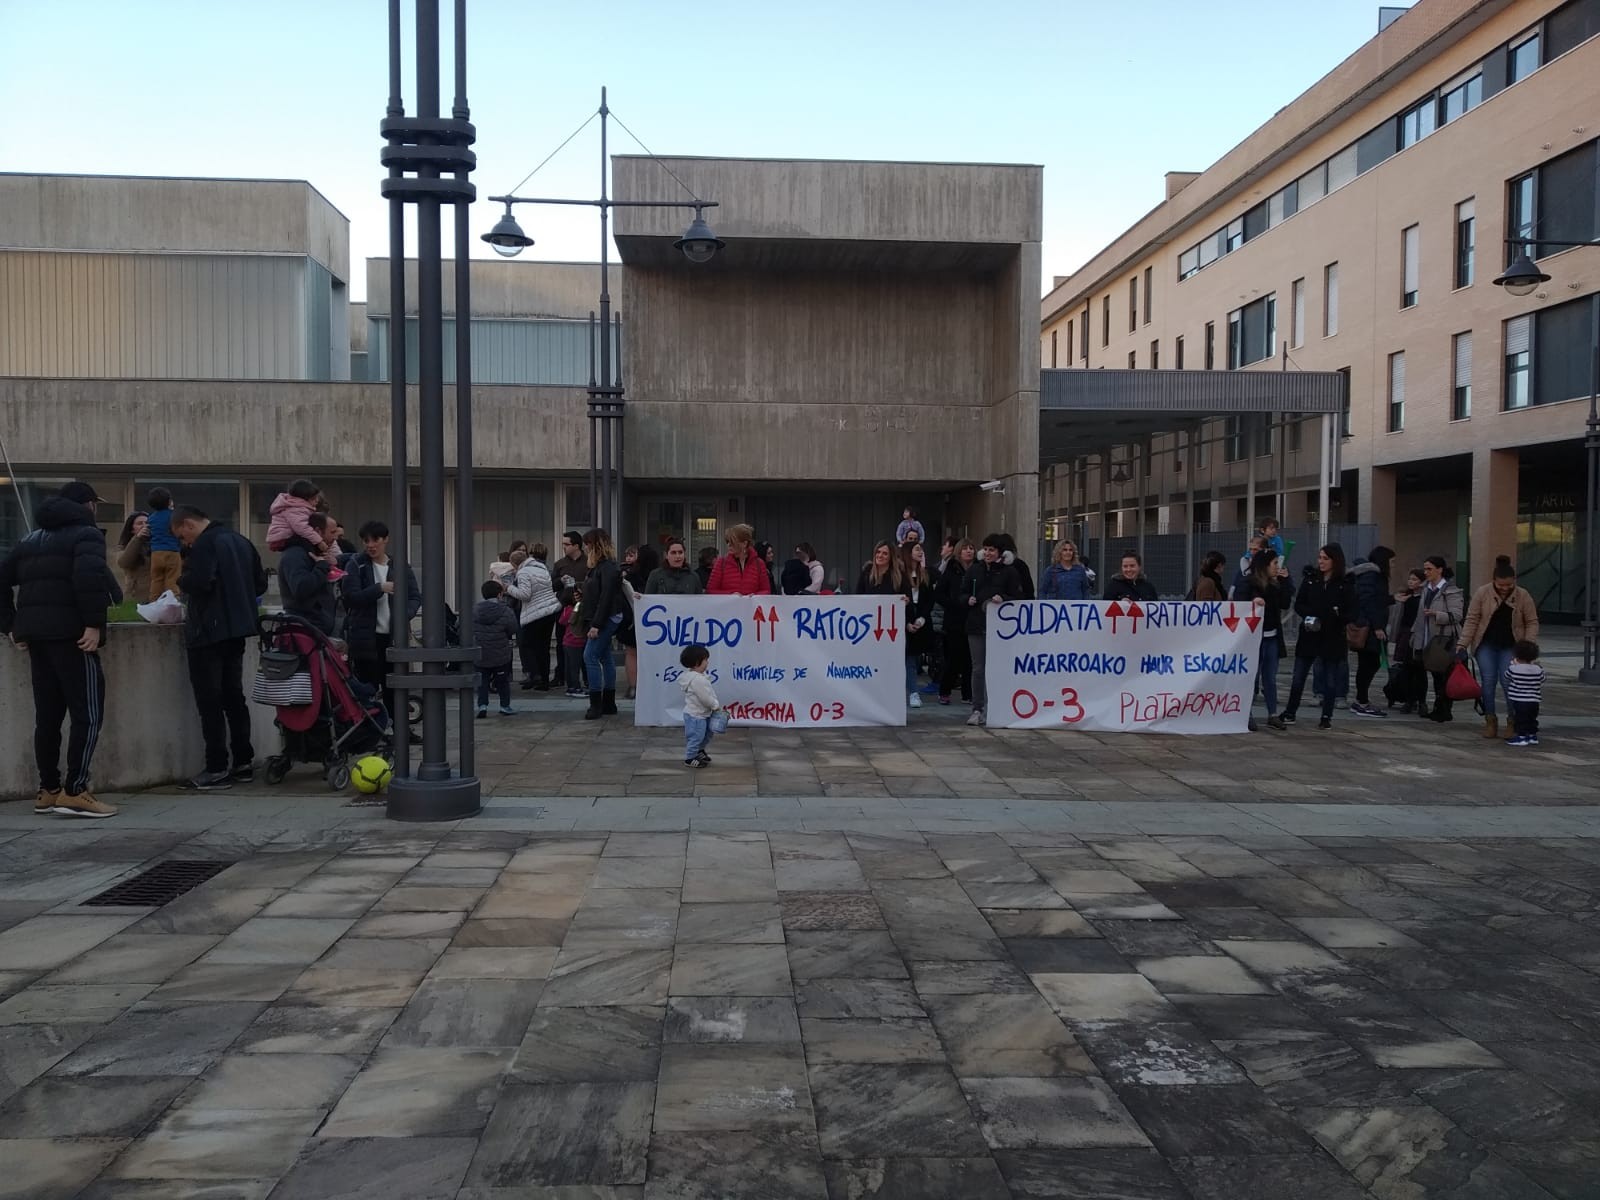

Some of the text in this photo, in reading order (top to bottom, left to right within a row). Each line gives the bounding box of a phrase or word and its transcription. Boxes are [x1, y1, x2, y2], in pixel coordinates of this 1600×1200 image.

[641, 604, 743, 648] SUELDO
[997, 602, 1223, 640] SOLDATA RATIOAK
[792, 666, 808, 680] DE
[1014, 652, 1249, 676] NAFARROAKO HAUR ESKOLAK
[810, 702, 845, 721] 0-3
[1011, 687, 1086, 723] 0-3
